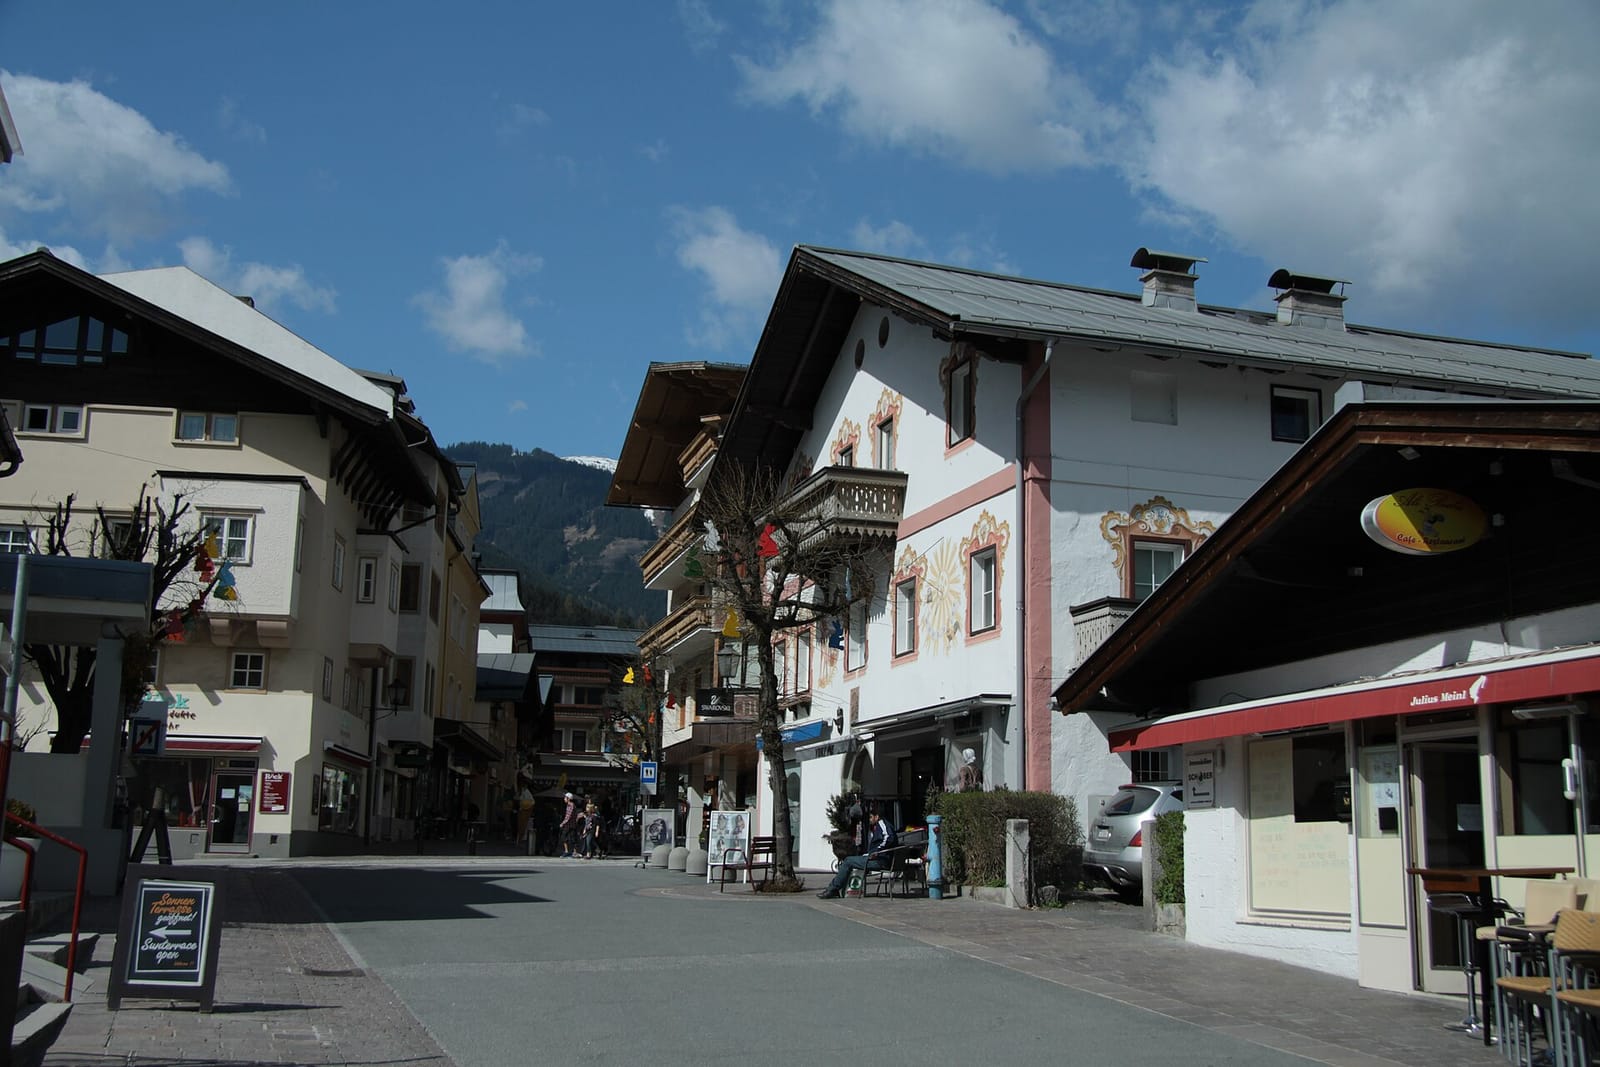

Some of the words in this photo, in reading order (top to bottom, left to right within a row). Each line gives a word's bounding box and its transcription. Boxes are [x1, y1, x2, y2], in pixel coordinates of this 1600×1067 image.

[1410, 696, 1438, 706] Julius
[1440, 690, 1467, 702] Meinl
[161, 893, 195, 905] Sonnen
[150, 901, 193, 914] Terrasse
[141, 938, 198, 951] Sunterrace
[156, 952, 179, 964] open
